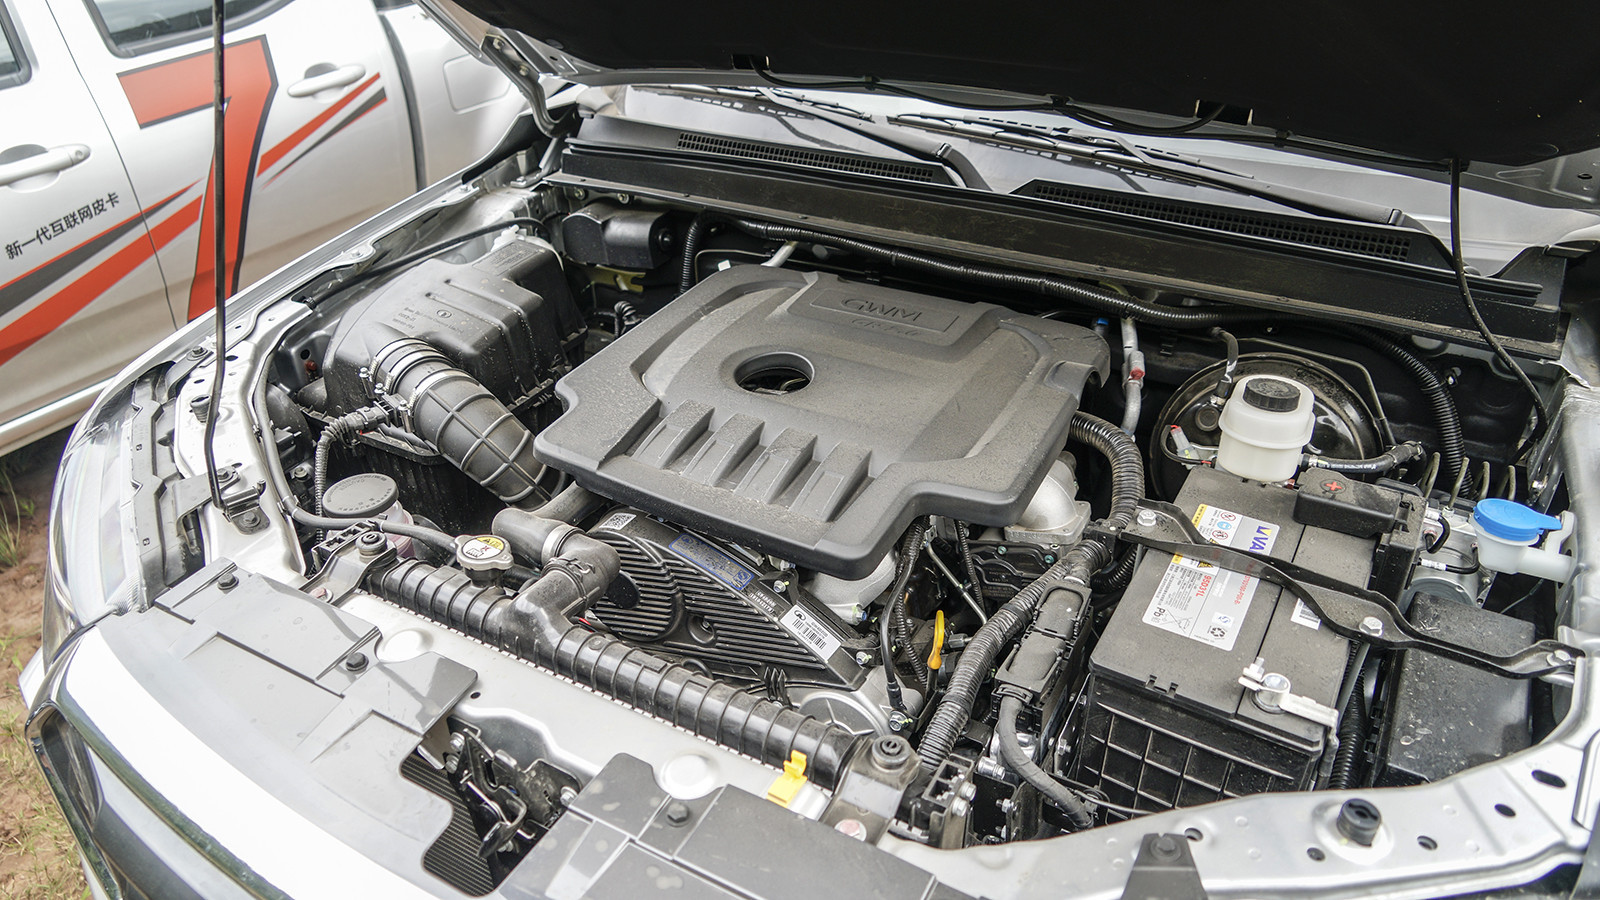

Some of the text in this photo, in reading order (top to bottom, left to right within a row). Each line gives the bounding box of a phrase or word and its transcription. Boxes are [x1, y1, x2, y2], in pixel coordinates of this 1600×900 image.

[117, 34, 278, 323] 7
[5, 192, 119, 259] 新一代互联网皮卡
[841, 299, 922, 321] GWM
[1249, 536, 1268, 554] VA
[1195, 575, 1212, 597] 95D31L
[1153, 606, 1165, 617] Pb
